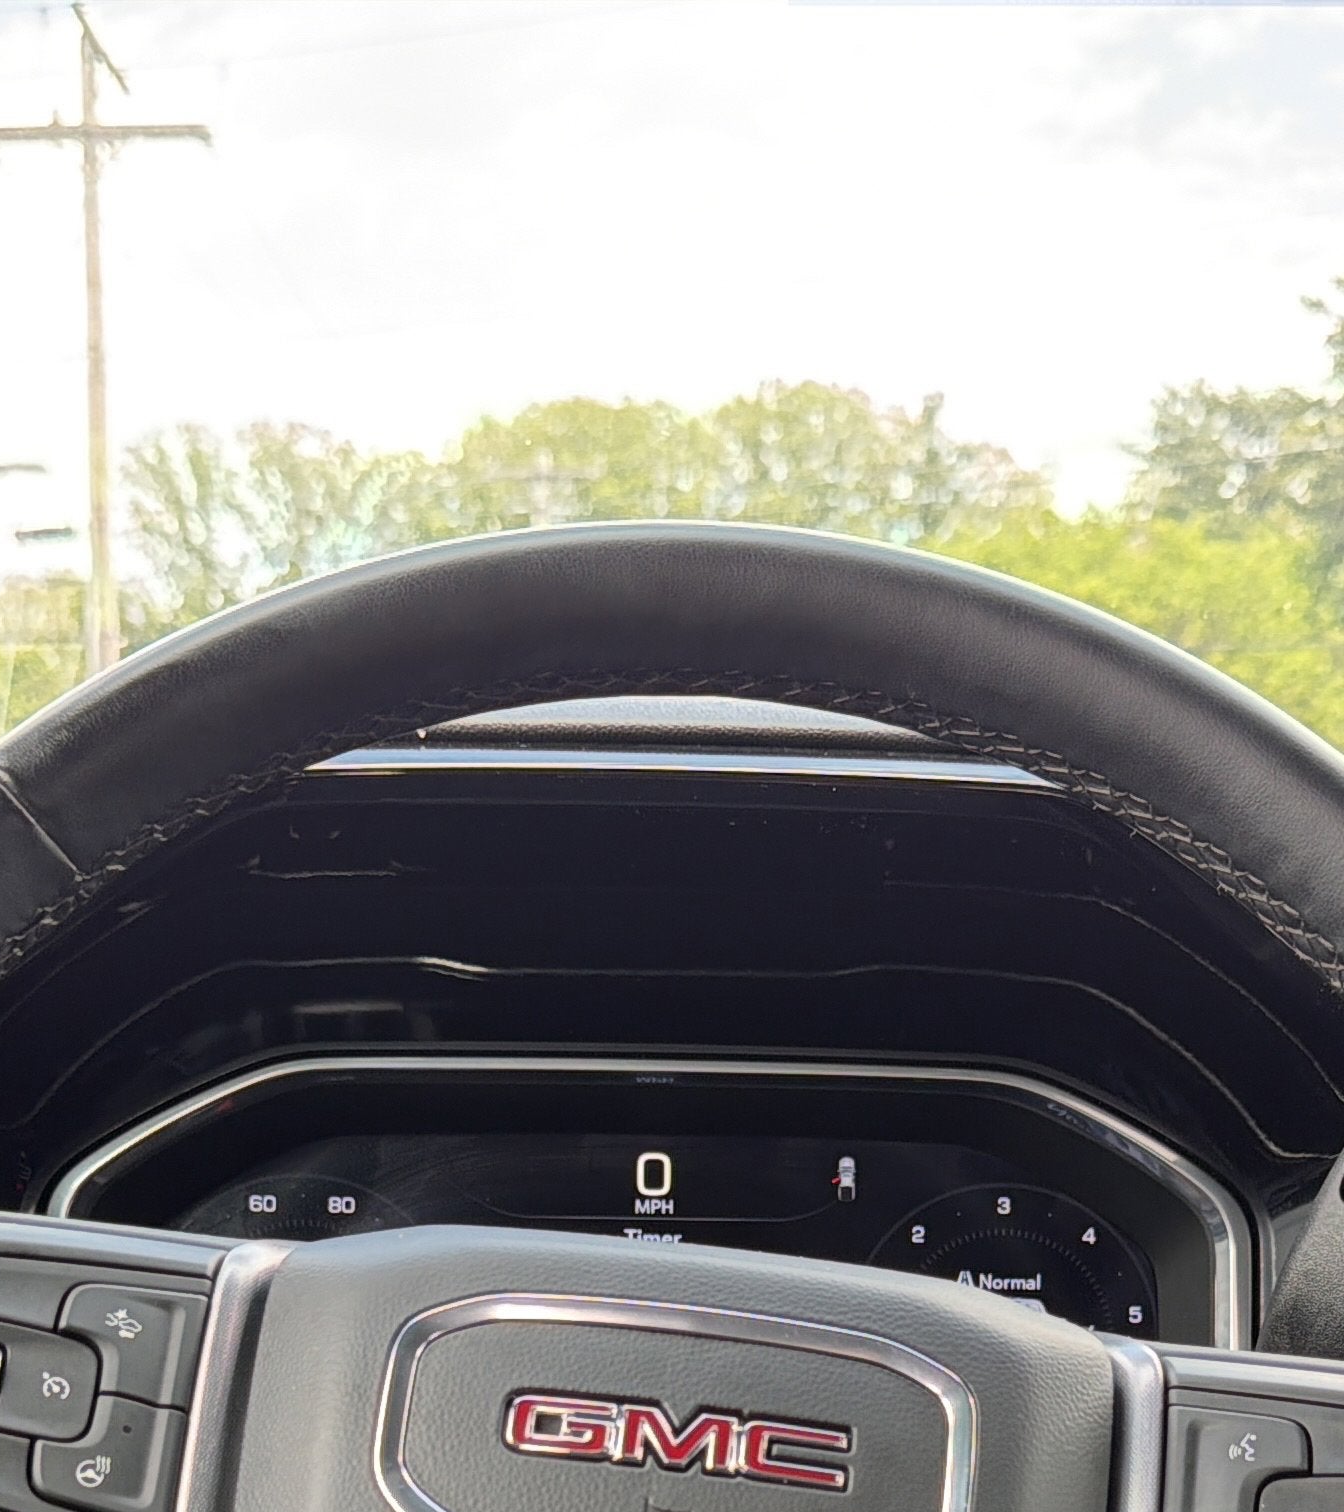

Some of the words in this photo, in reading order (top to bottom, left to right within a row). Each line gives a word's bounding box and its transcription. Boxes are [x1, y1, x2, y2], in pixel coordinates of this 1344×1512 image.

[635, 1151, 672, 1196] 0
[248, 1194, 276, 1213] 60
[327, 1195, 355, 1214] 80
[634, 1198, 674, 1214] MPH
[996, 1196, 1010, 1214] 3
[911, 1224, 925, 1243] 2
[1081, 1226, 1096, 1244] 4
[978, 1270, 1040, 1290] Normal
[1128, 1305, 1142, 1323] 5
[506, 1393, 849, 1489] GMC
